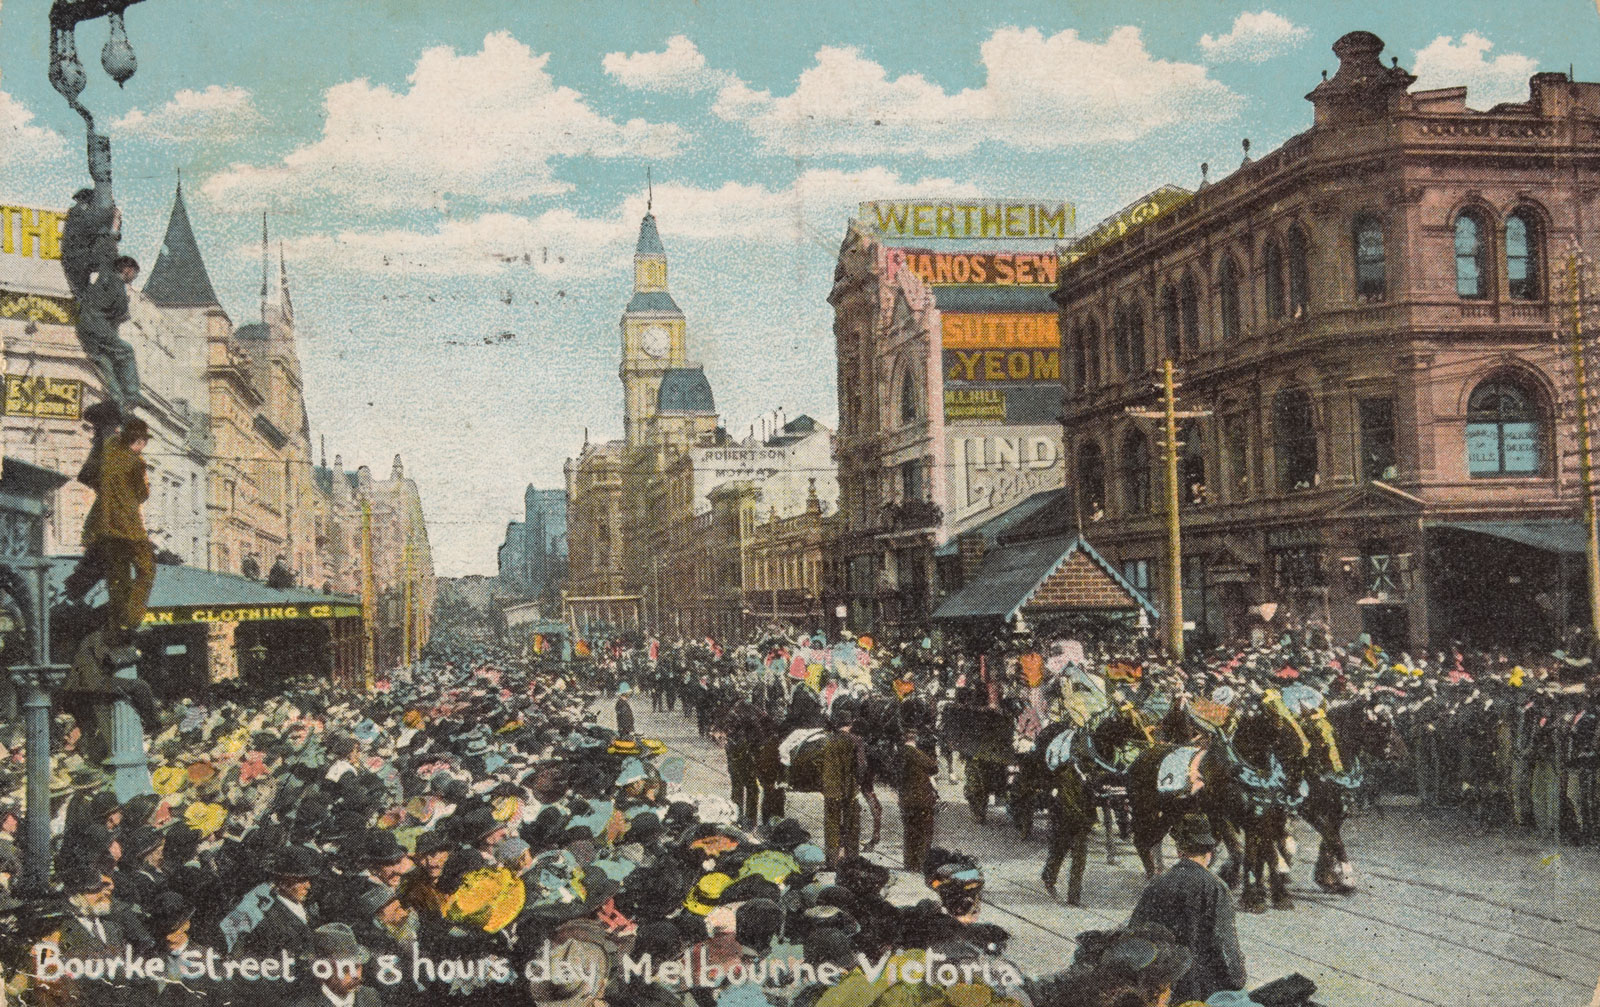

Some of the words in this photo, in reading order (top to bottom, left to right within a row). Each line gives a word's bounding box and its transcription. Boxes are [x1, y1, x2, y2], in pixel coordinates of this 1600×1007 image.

[0, 205, 67, 260] THE
[875, 203, 1065, 239] WERTHEIM
[956, 351, 1060, 380] YEOM
[191, 606, 298, 622] CLOTHING
